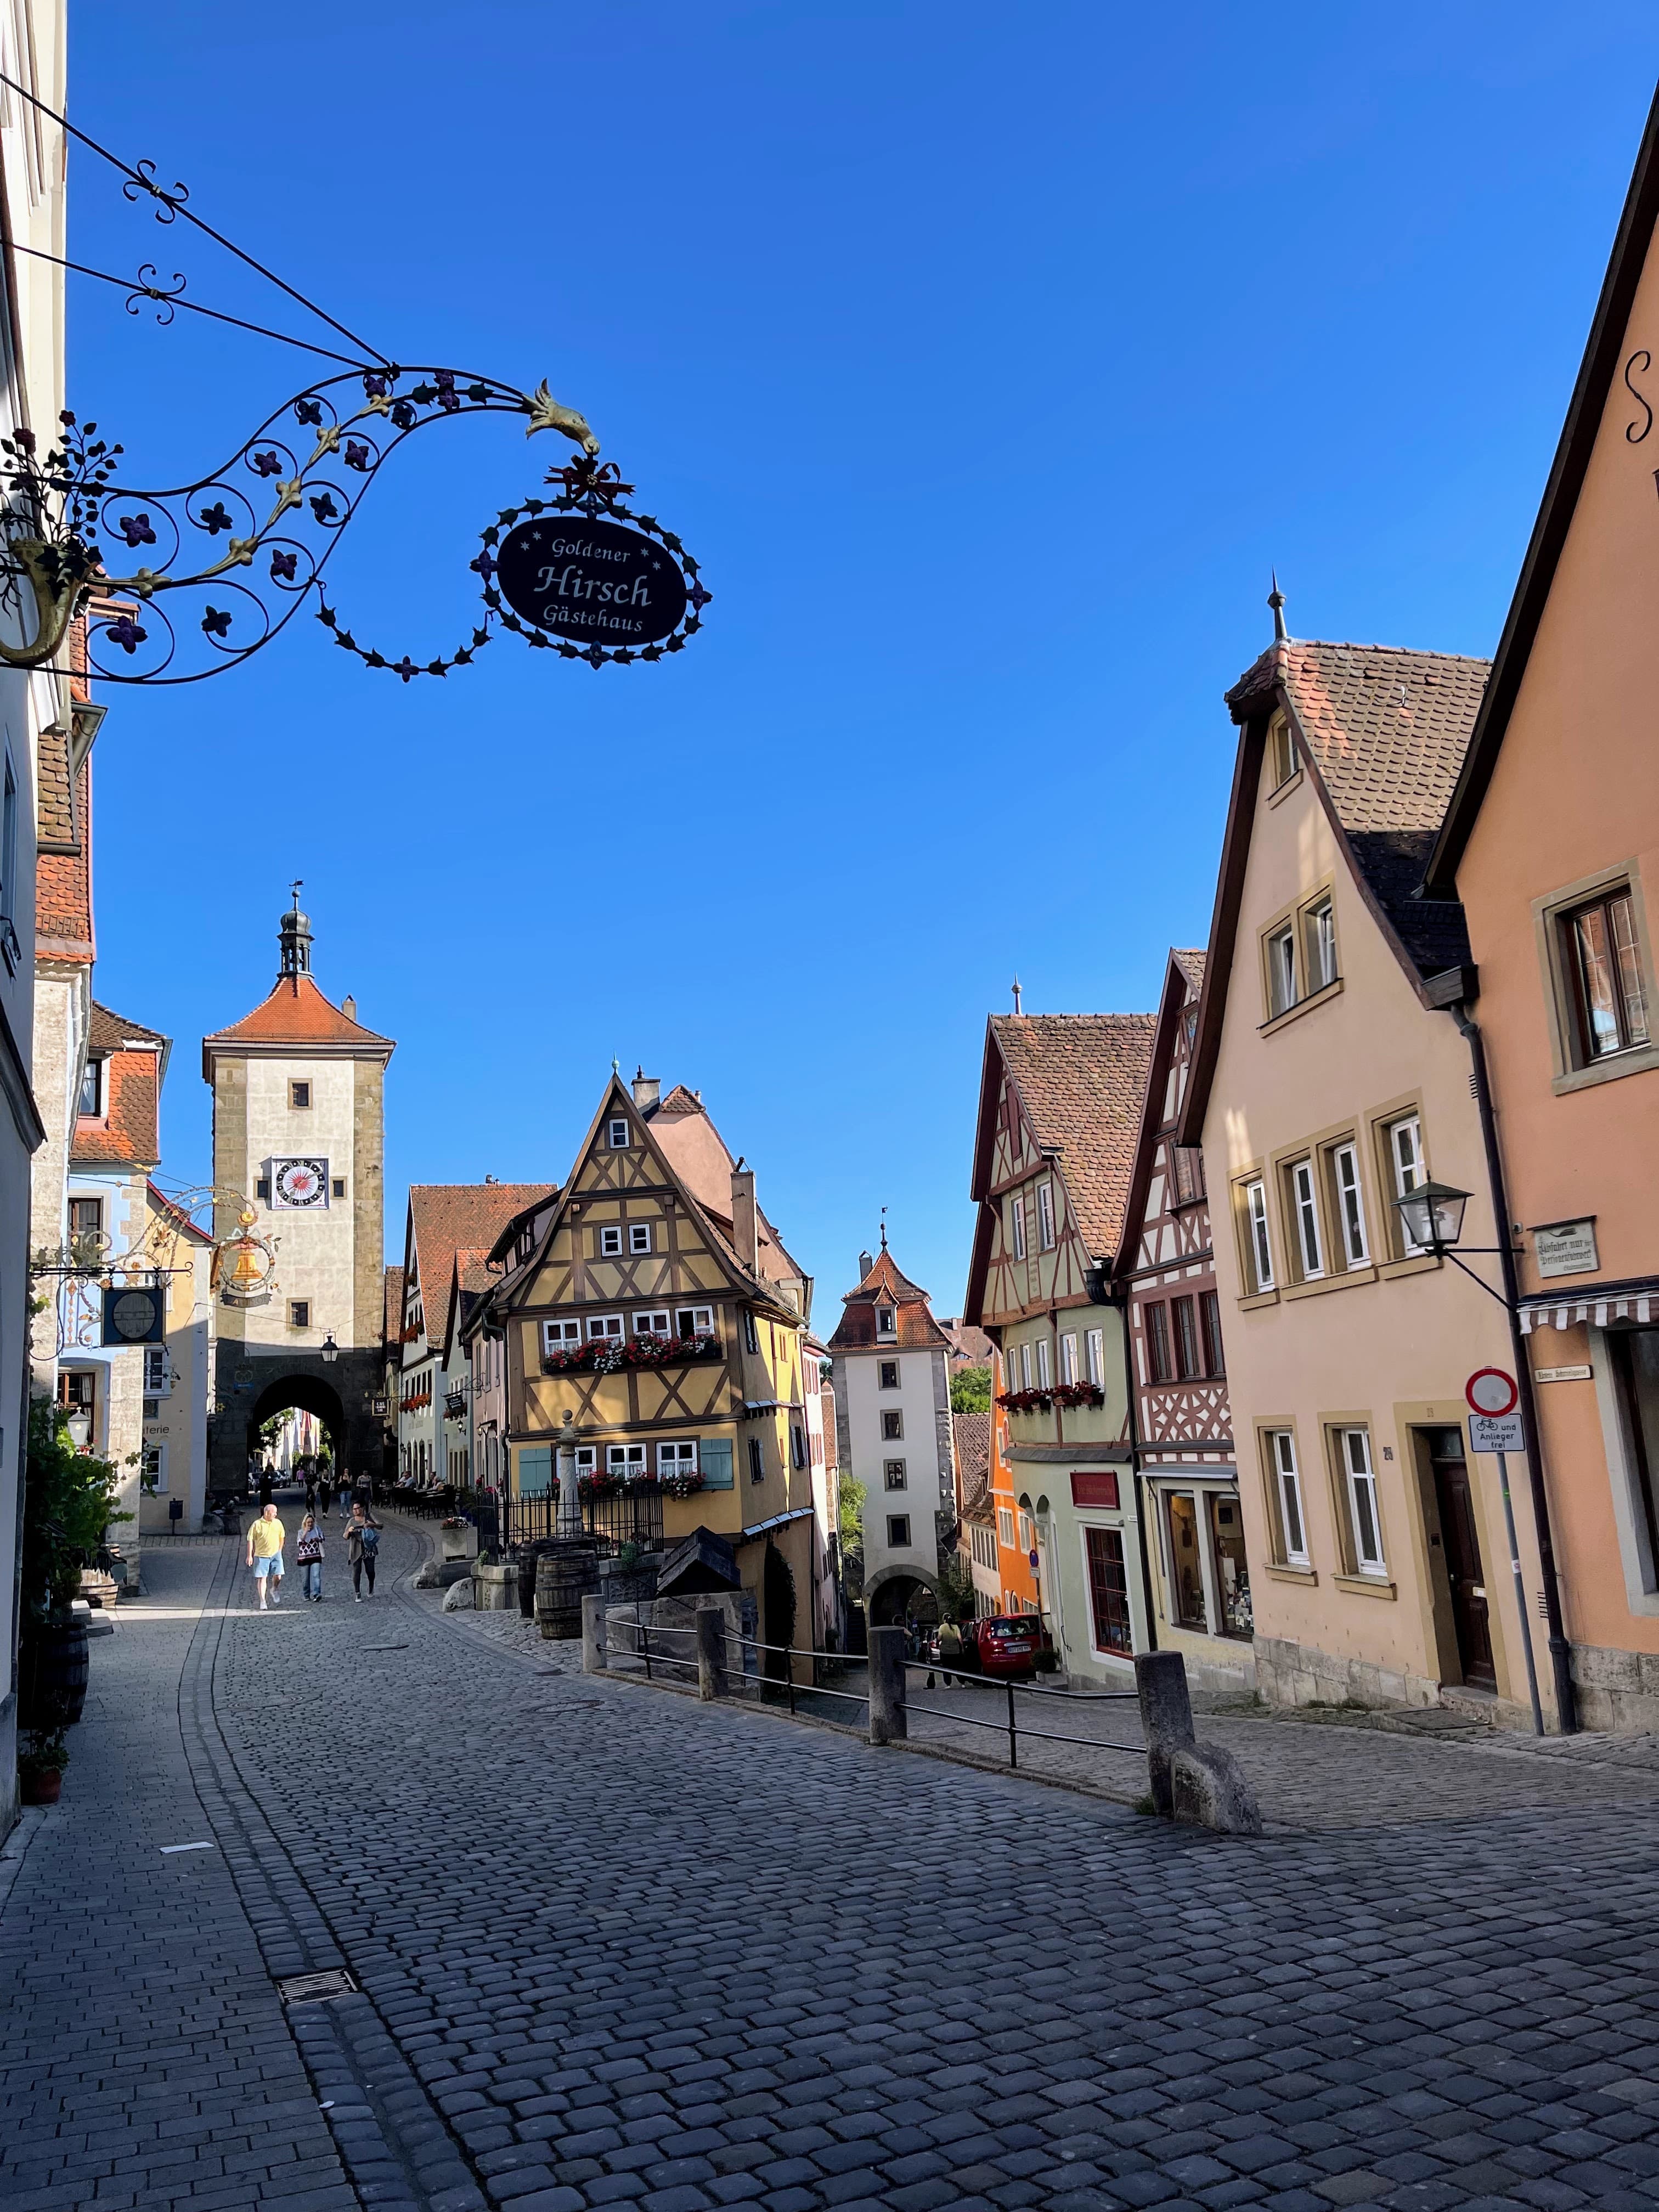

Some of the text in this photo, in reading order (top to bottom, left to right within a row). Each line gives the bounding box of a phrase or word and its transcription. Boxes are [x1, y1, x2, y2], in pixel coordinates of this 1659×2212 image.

[552, 538, 631, 562] Goldener
[534, 565, 652, 607] Hirsch
[543, 605, 644, 632] Gästehaus
[1570, 1240, 1583, 1249] nur
